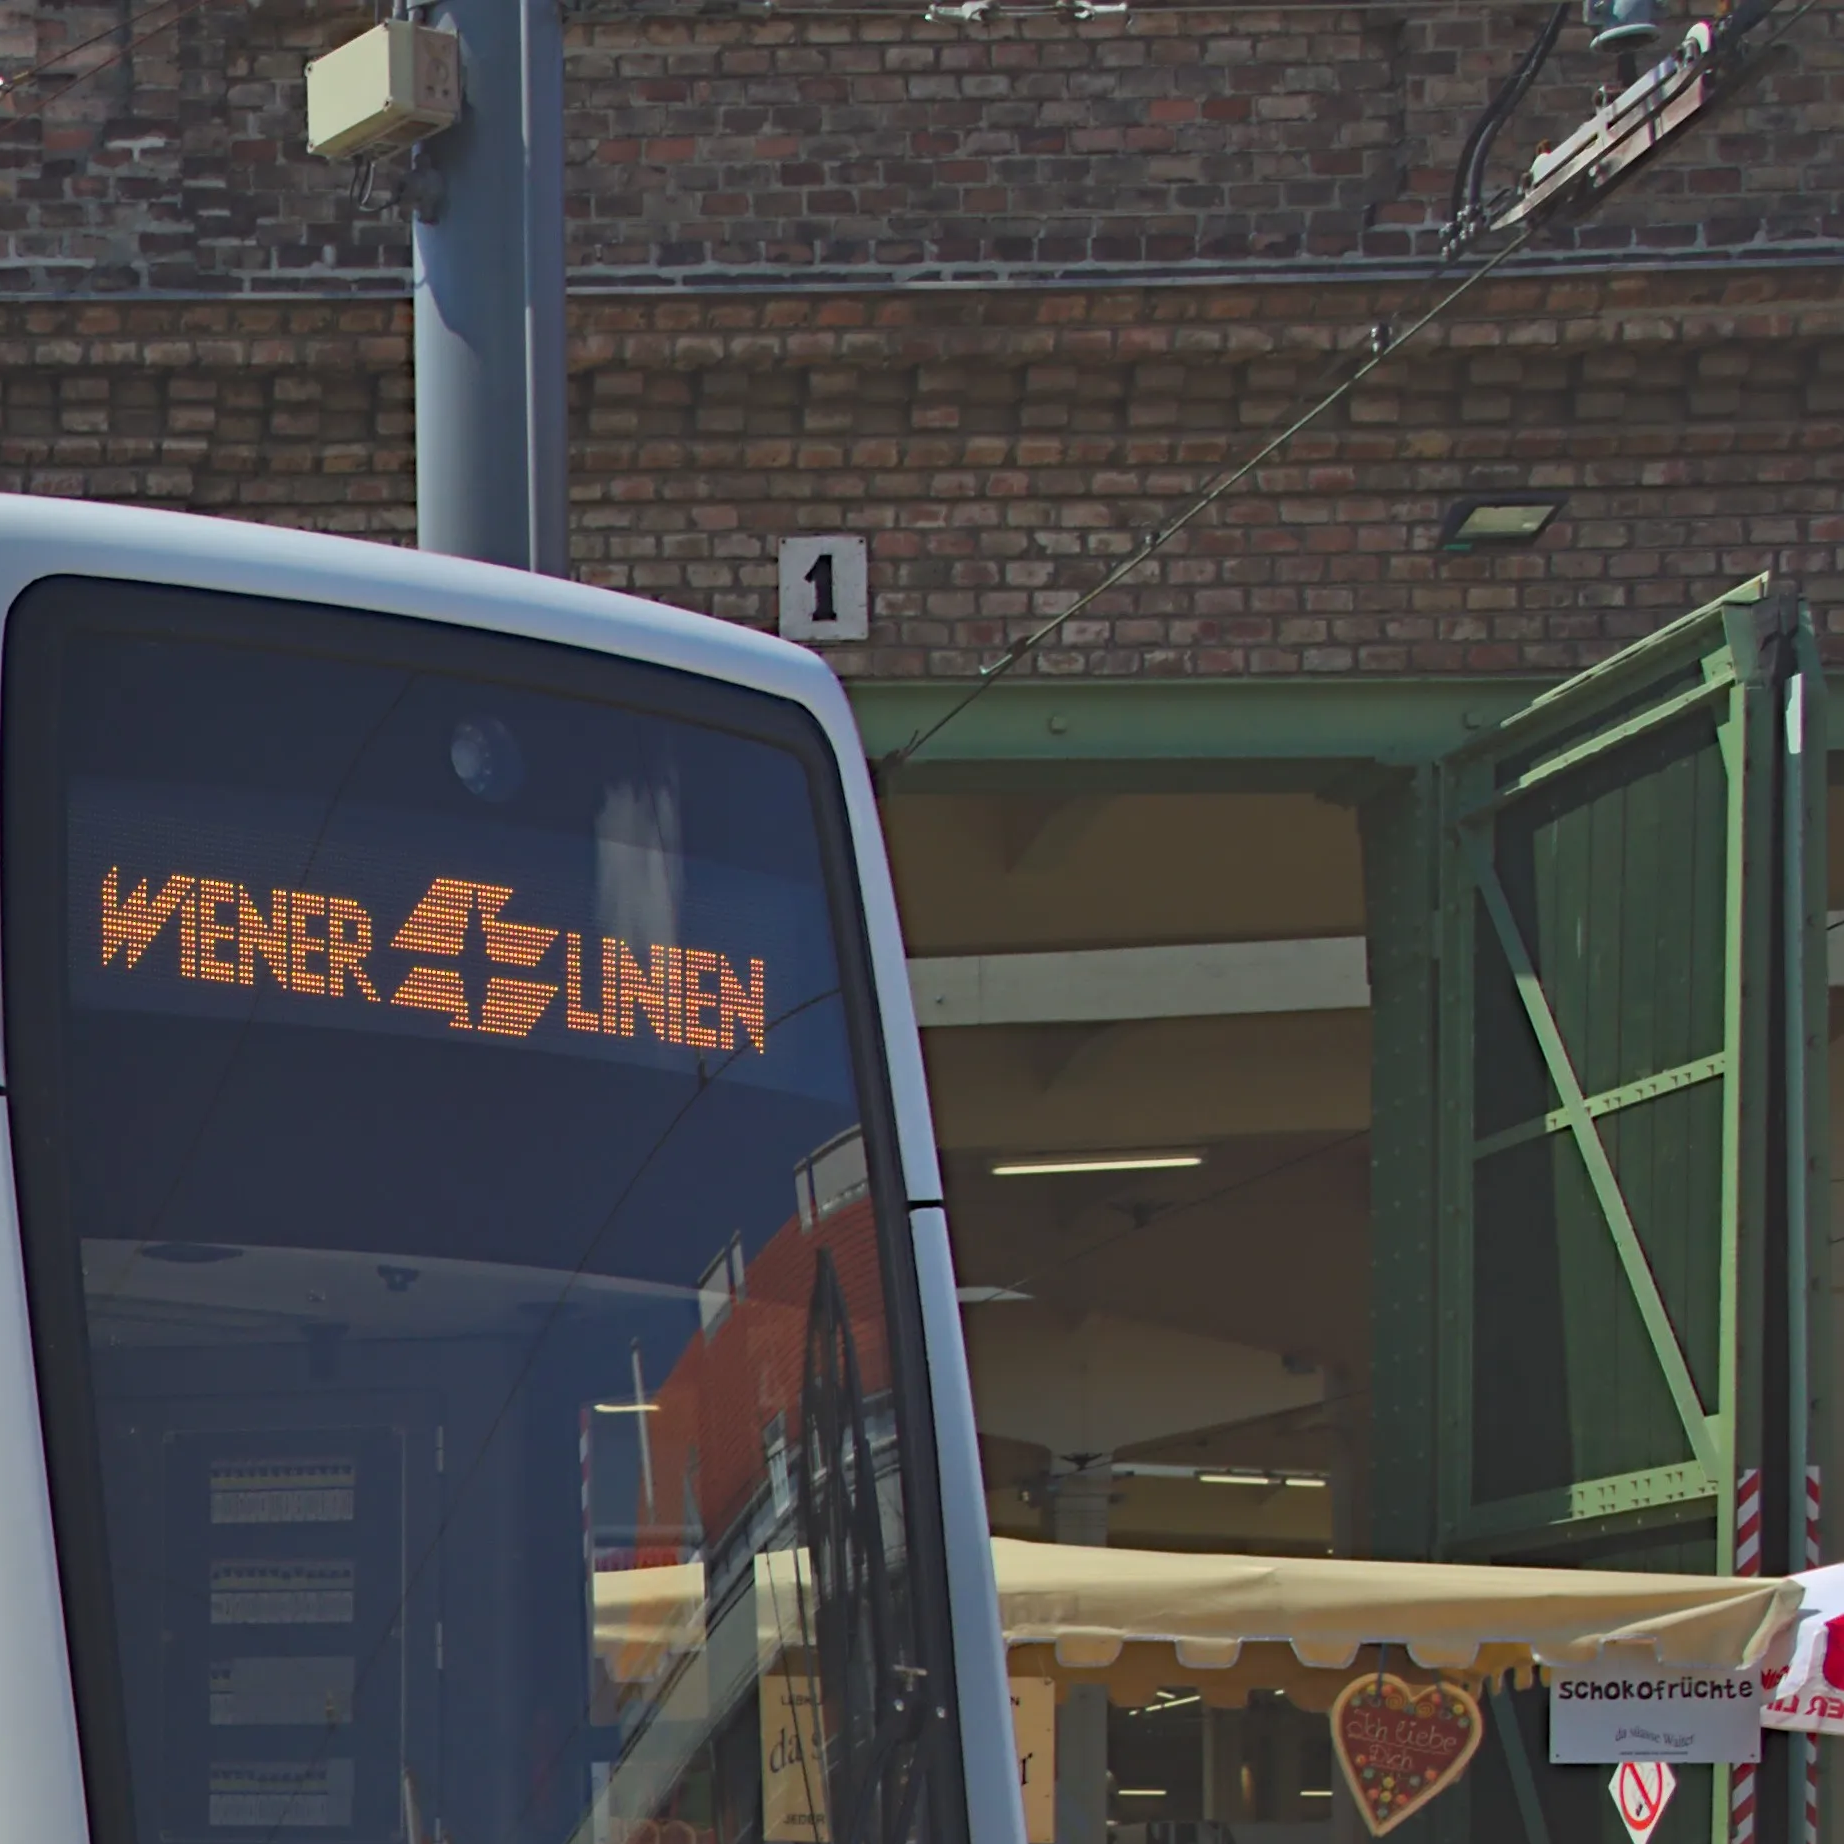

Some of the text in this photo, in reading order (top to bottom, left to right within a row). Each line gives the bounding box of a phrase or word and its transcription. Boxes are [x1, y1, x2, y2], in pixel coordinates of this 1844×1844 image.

[804, 554, 838, 621] 1
[101, 866, 767, 1054] WIENER LINIEN
[1395, 1720, 1457, 1752] liebe
